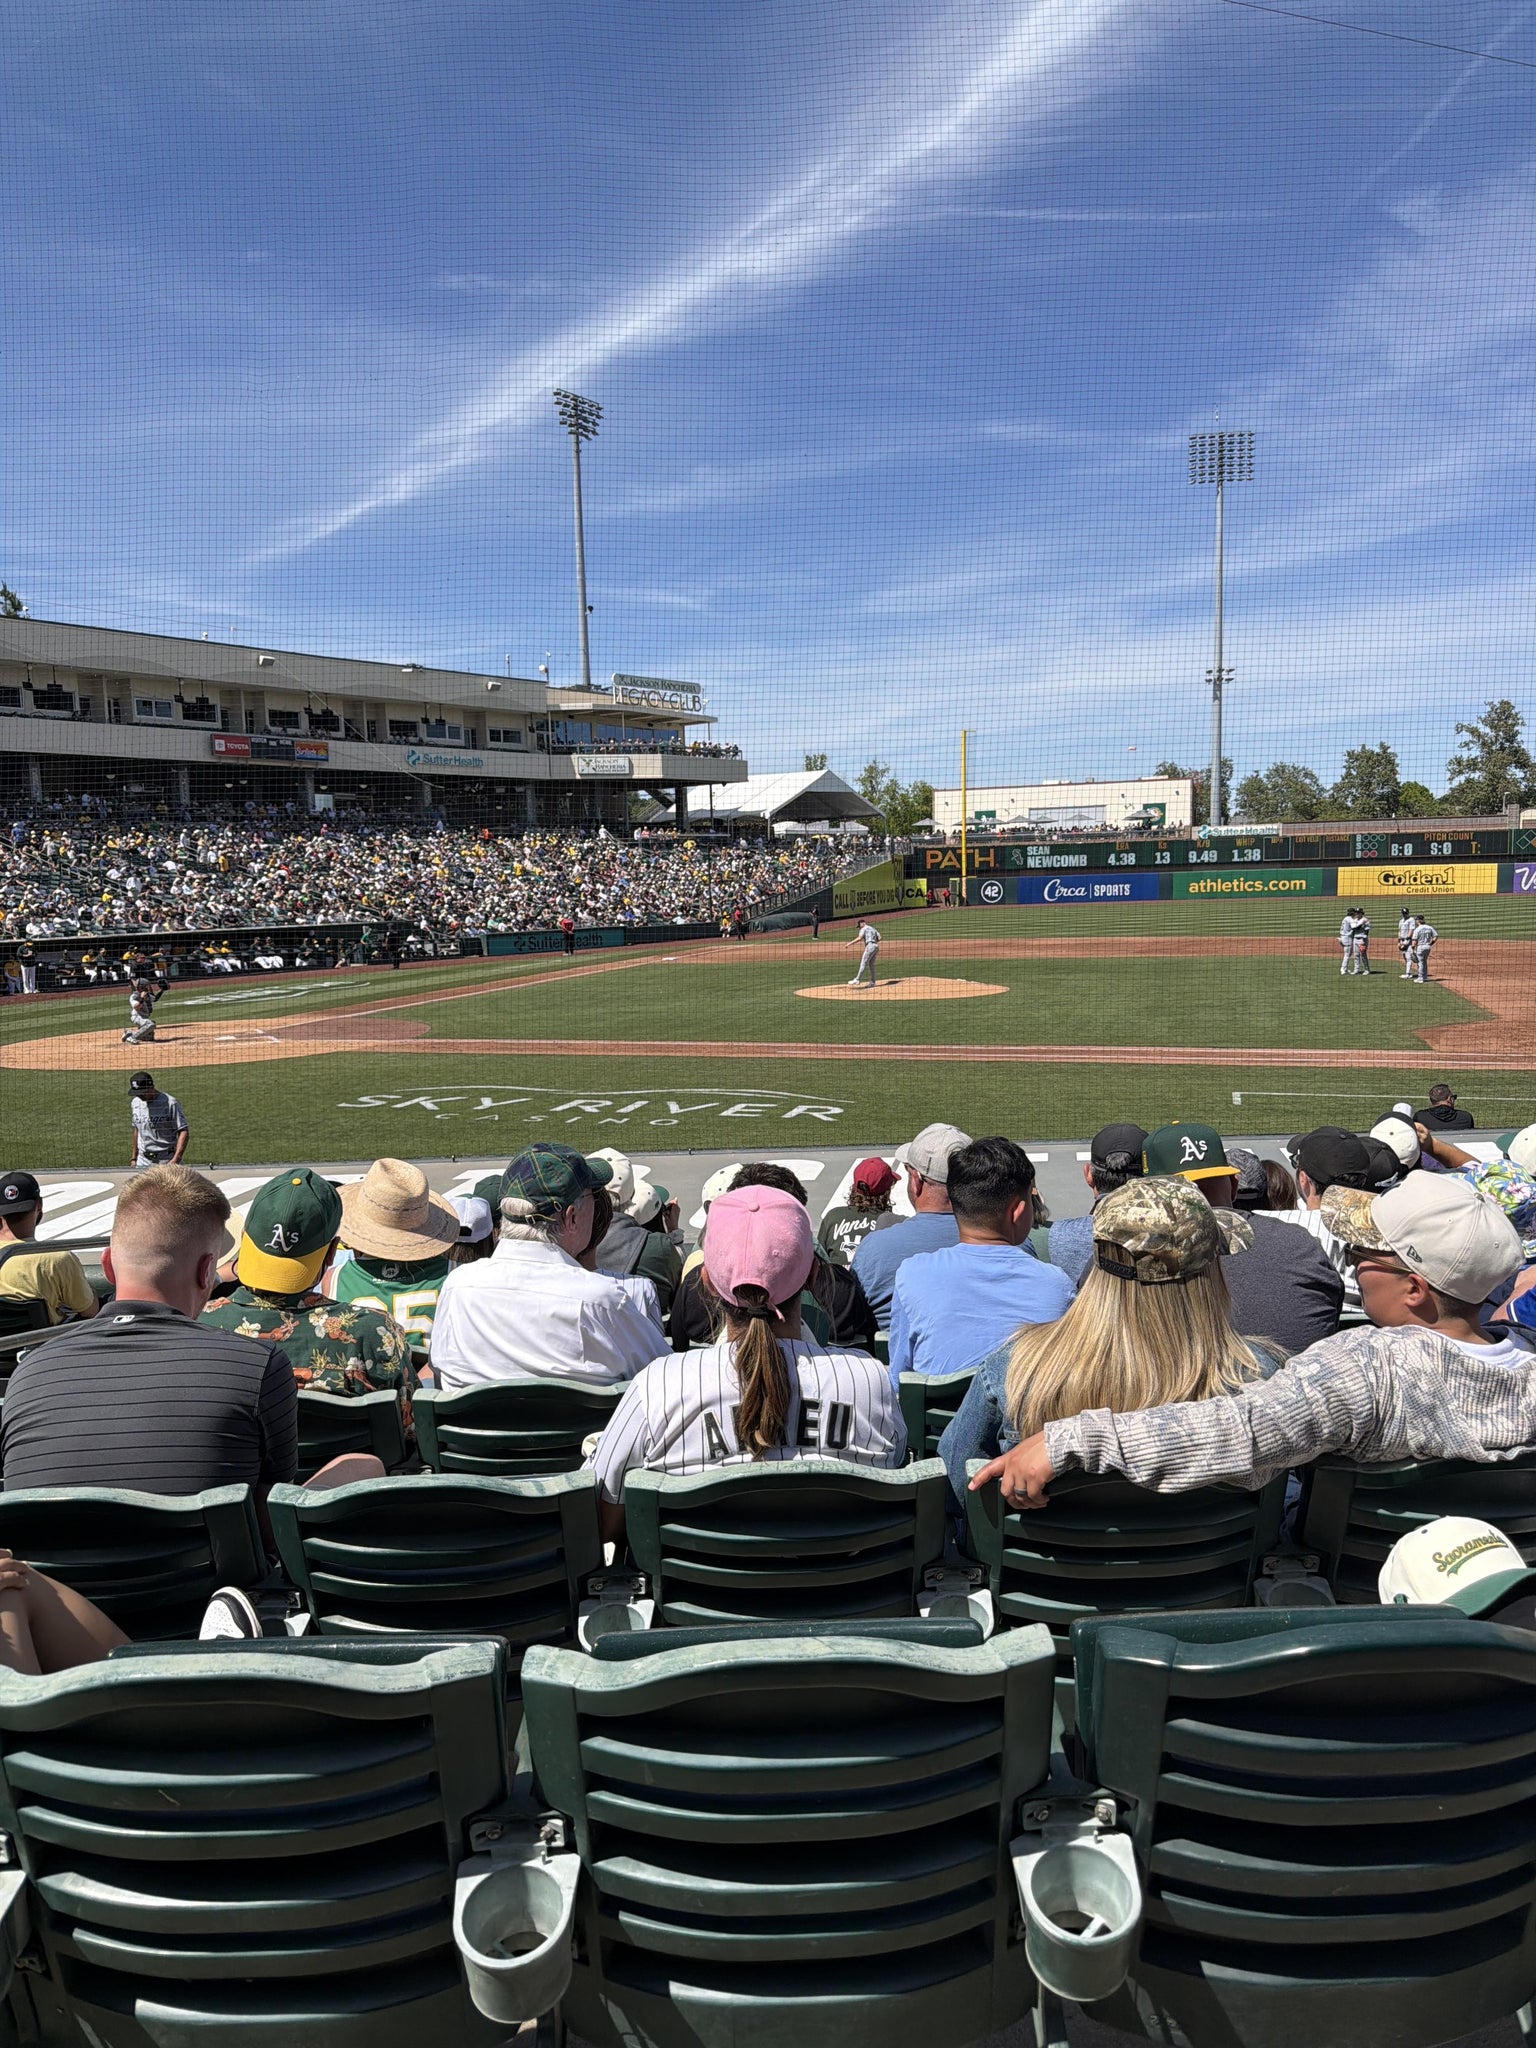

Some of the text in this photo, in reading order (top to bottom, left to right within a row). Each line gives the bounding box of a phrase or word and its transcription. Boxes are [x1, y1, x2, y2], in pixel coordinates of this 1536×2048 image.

[615, 686, 702, 711] LEGACY CLUB
[226, 742, 249, 750] TOYOTA
[1235, 837, 1256, 847] WHIP
[1355, 834, 1362, 842] B
[1424, 832, 1474, 841] PITCH COUNT
[1026, 845, 1050, 855] SEAN
[1355, 842, 1362, 850] S
[1026, 854, 1088, 868] NEWCOMB
[1107, 853, 1136, 865] 4.38
[1154, 851, 1170, 864] 13
[1188, 850, 1218, 863] 9.49
[1231, 848, 1261, 862] 1.38
[1188, 877, 1306, 893] athletics.com
[1515, 867, 1536, 891] V
[984, 885, 999, 897] 42
[1043, 878, 1130, 902] Circa SPORTS
[1406, 886, 1430, 894] Credit
[834, 892, 849, 910] CALL
[527, 932, 604, 950] Sutter ealth
[336, 1094, 844, 1122] SKY RIVER
[435, 1112, 680, 1126] CASINO
[1180, 1136, 1208, 1165] A's
[833, 1217, 870, 1240] Vans
[264, 1223, 299, 1252] A's
[703, 1398, 853, 1461] AEU
